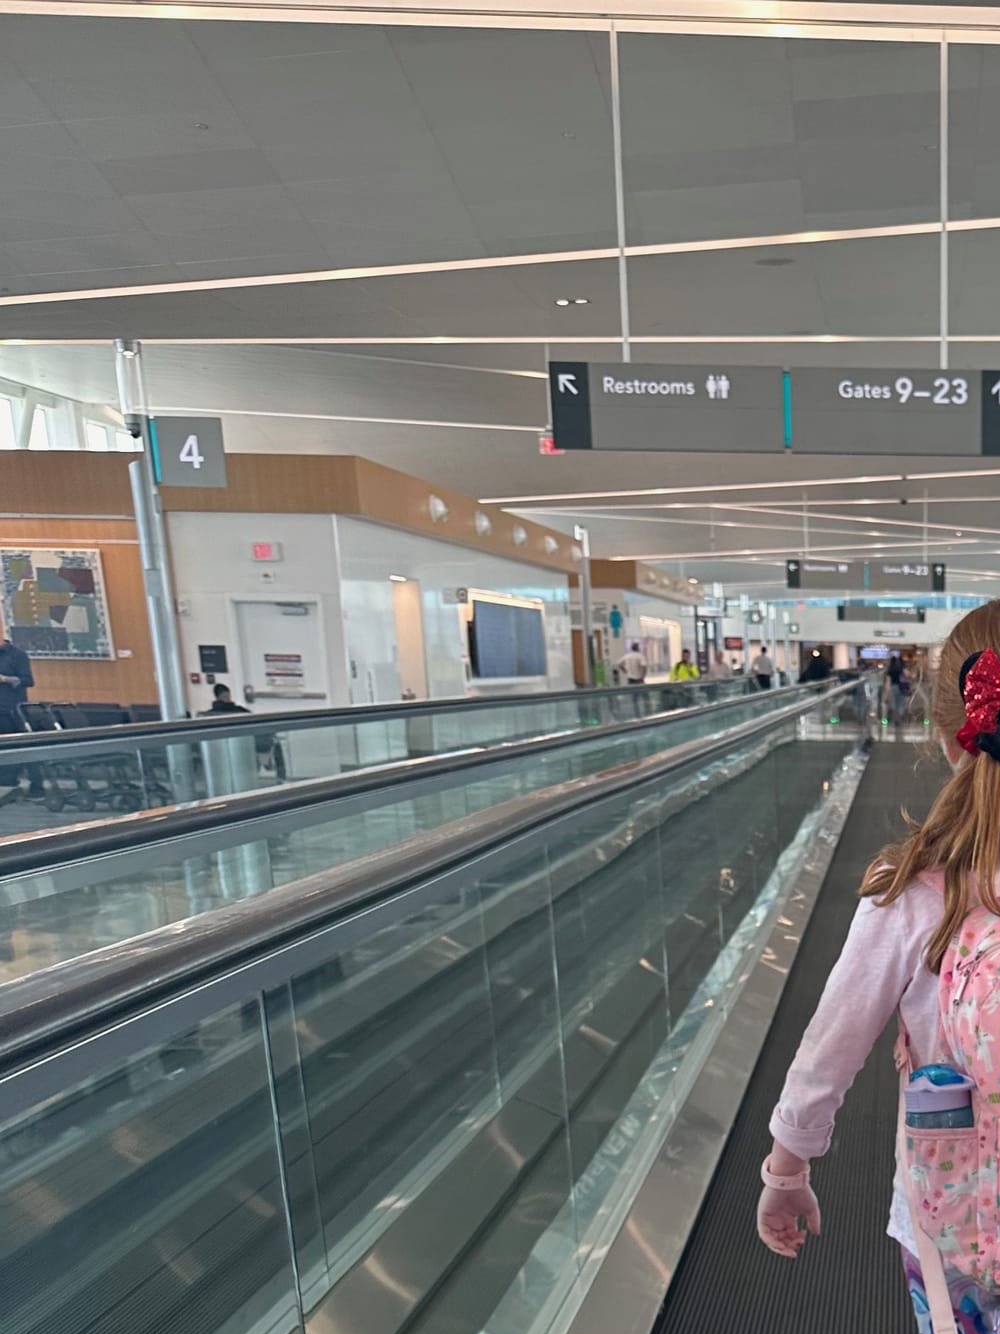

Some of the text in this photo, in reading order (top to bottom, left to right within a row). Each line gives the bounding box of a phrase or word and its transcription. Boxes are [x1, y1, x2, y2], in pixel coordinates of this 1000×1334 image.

[602, 375, 696, 397] Restrooms
[838, 380, 891, 400] Gates
[179, 434, 205, 469] 4
